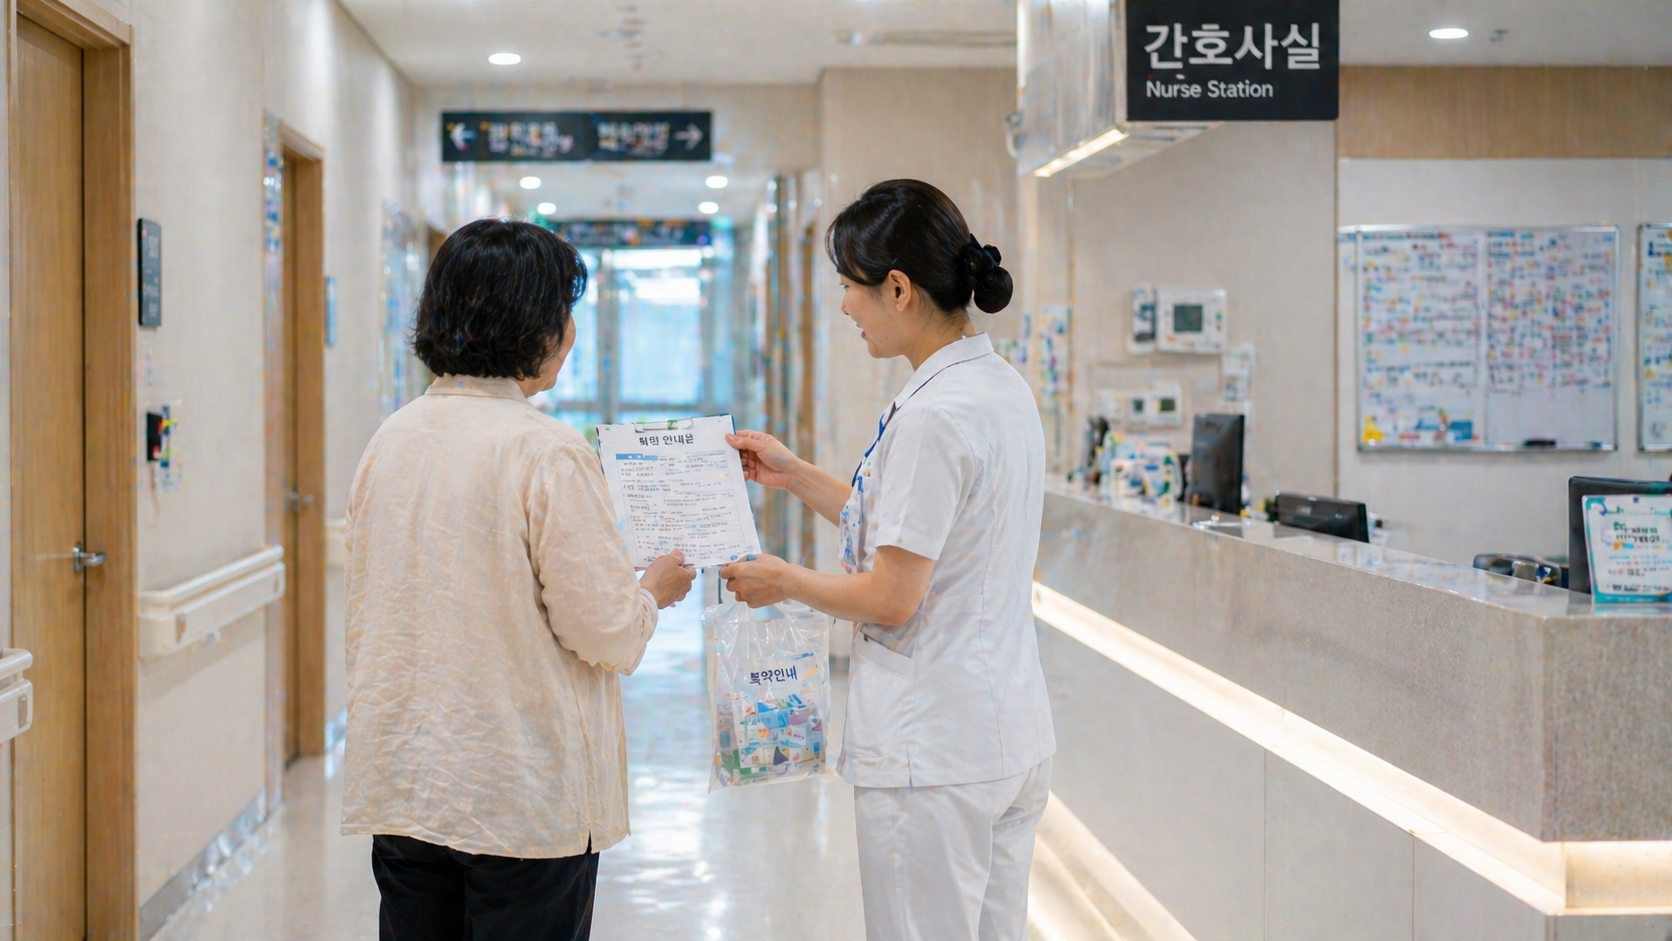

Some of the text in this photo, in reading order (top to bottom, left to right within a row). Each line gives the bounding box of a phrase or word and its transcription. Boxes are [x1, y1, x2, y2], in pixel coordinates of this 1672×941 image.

[1144, 22, 1320, 70] 간호사실
[1146, 79, 1273, 98] Nurse Station
